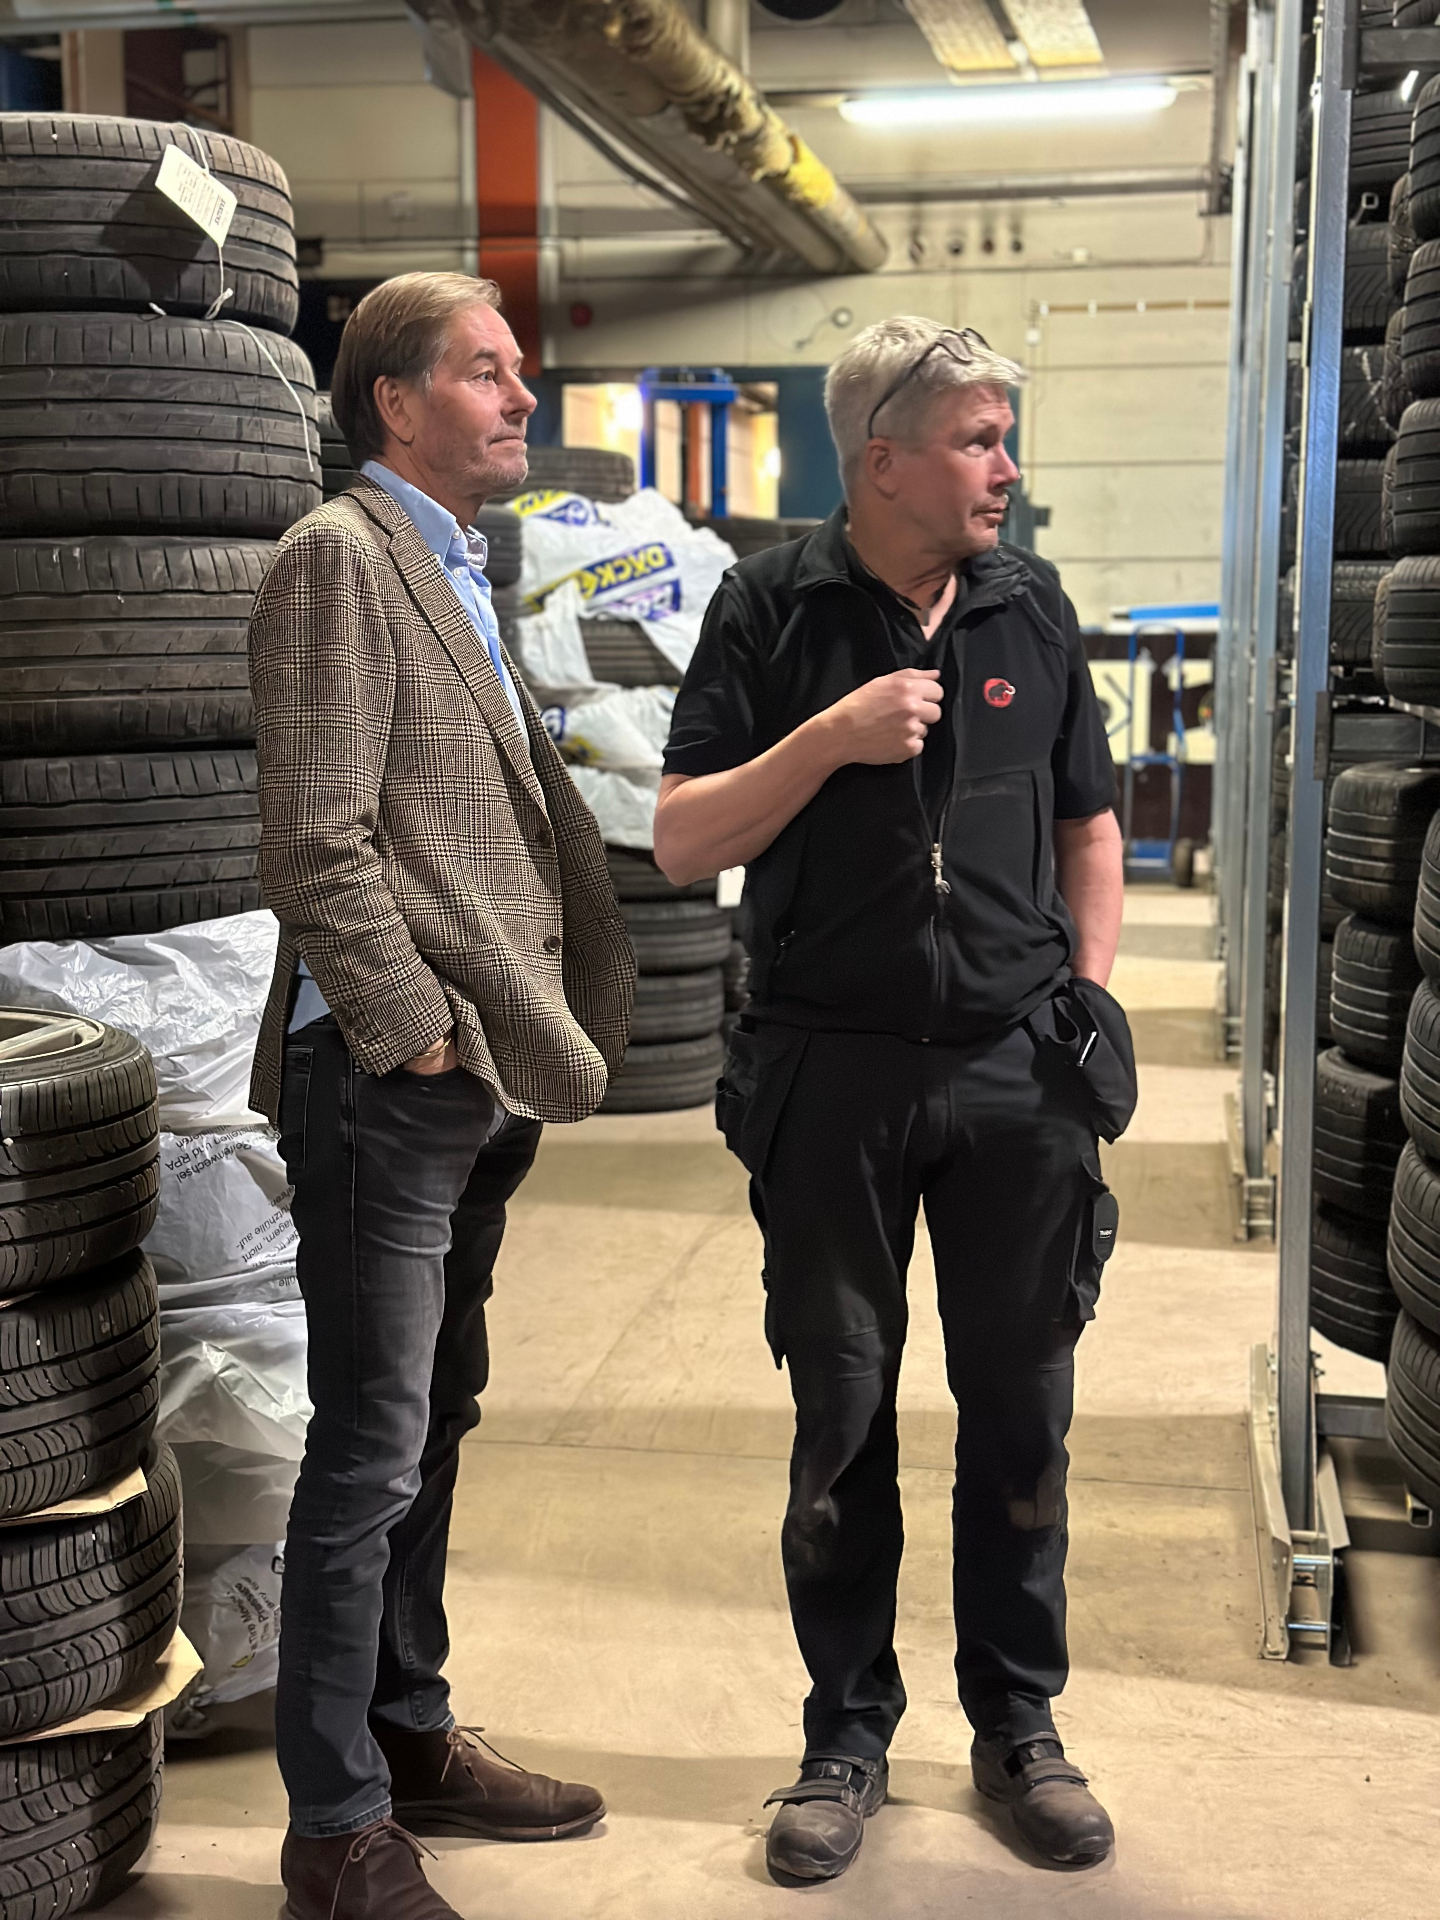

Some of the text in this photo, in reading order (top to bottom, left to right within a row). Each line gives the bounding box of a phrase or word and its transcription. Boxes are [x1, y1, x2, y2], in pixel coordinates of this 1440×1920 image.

[596, 546, 666, 588] DÄCK
[165, 1153, 191, 1171] RPA
[236, 1232, 253, 1250] auf-
[241, 1242, 263, 1263] nicht
